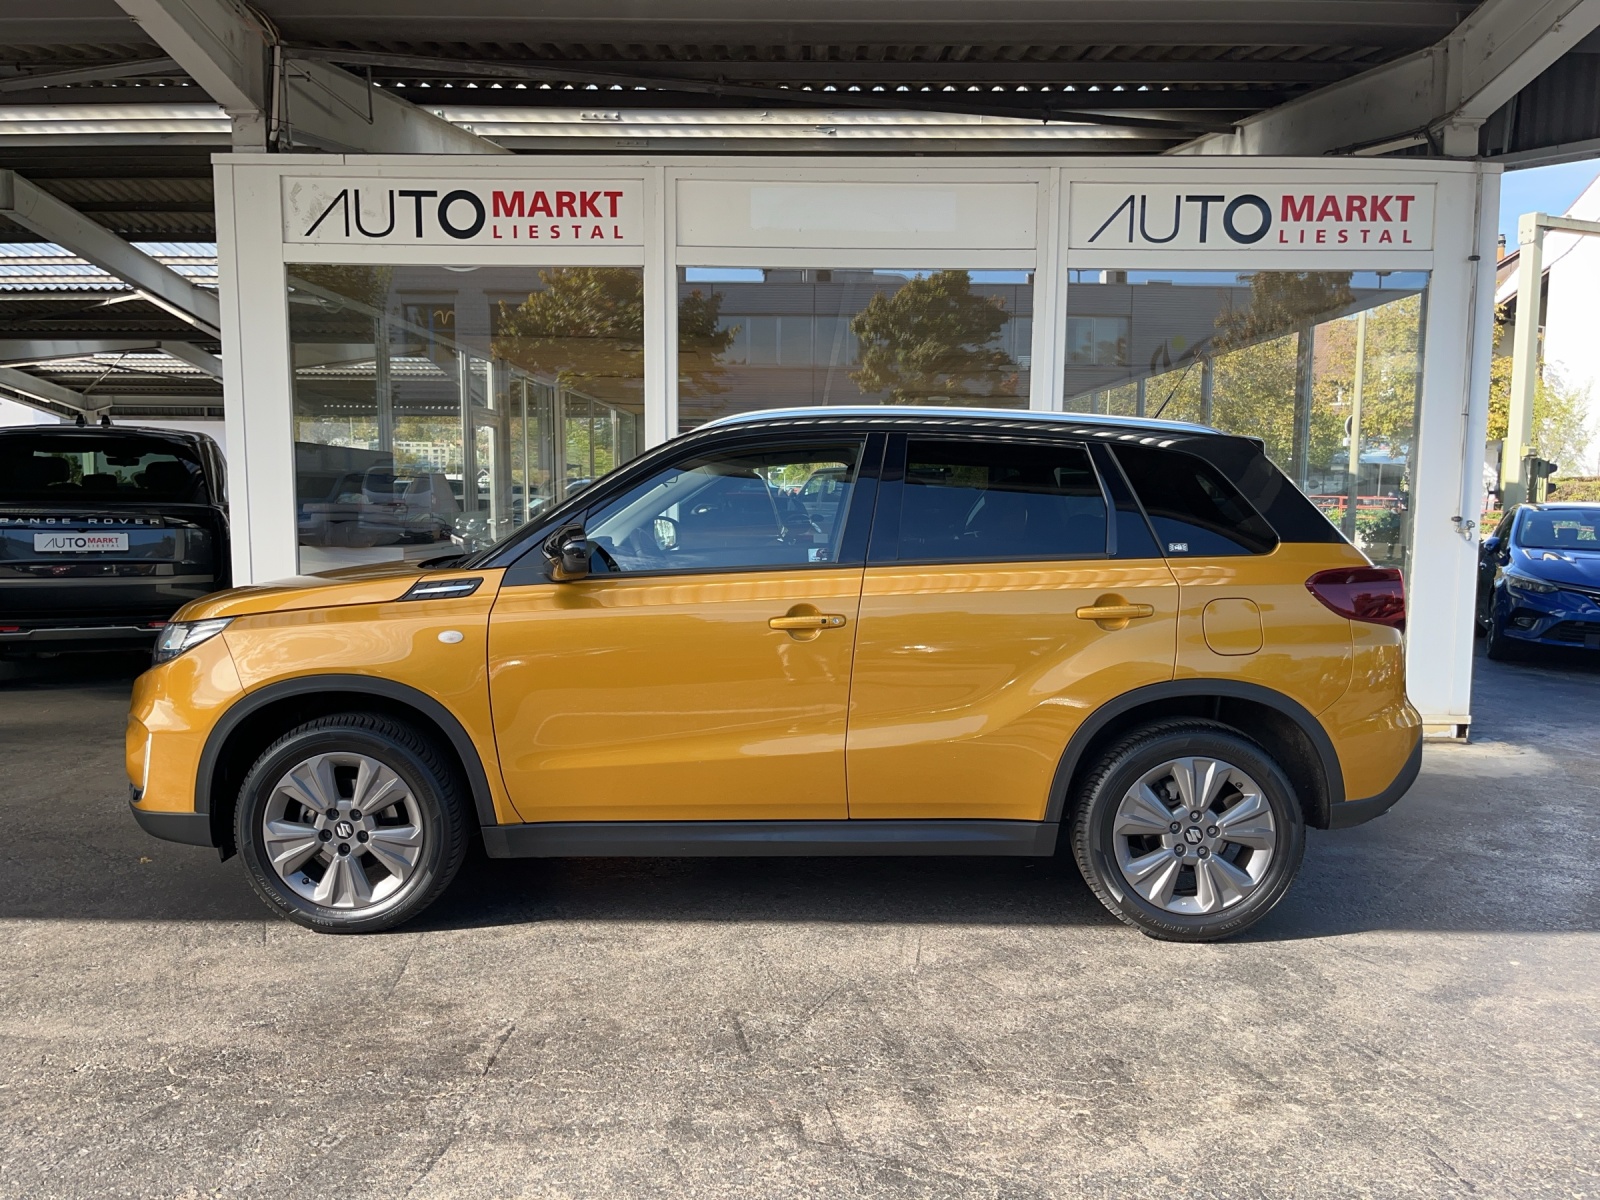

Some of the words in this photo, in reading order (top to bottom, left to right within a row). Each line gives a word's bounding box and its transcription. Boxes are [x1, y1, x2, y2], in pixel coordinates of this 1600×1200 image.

[304, 188, 486, 240] AUTO
[492, 190, 624, 219] MARKT
[1087, 193, 1272, 245] AUTO
[1279, 194, 1416, 223] MARKT
[492, 224, 624, 240] LIESTAL
[1278, 229, 1413, 244] LIESTAL
[0, 517, 71, 525] RANGE
[44, 537, 87, 549] AUTO
